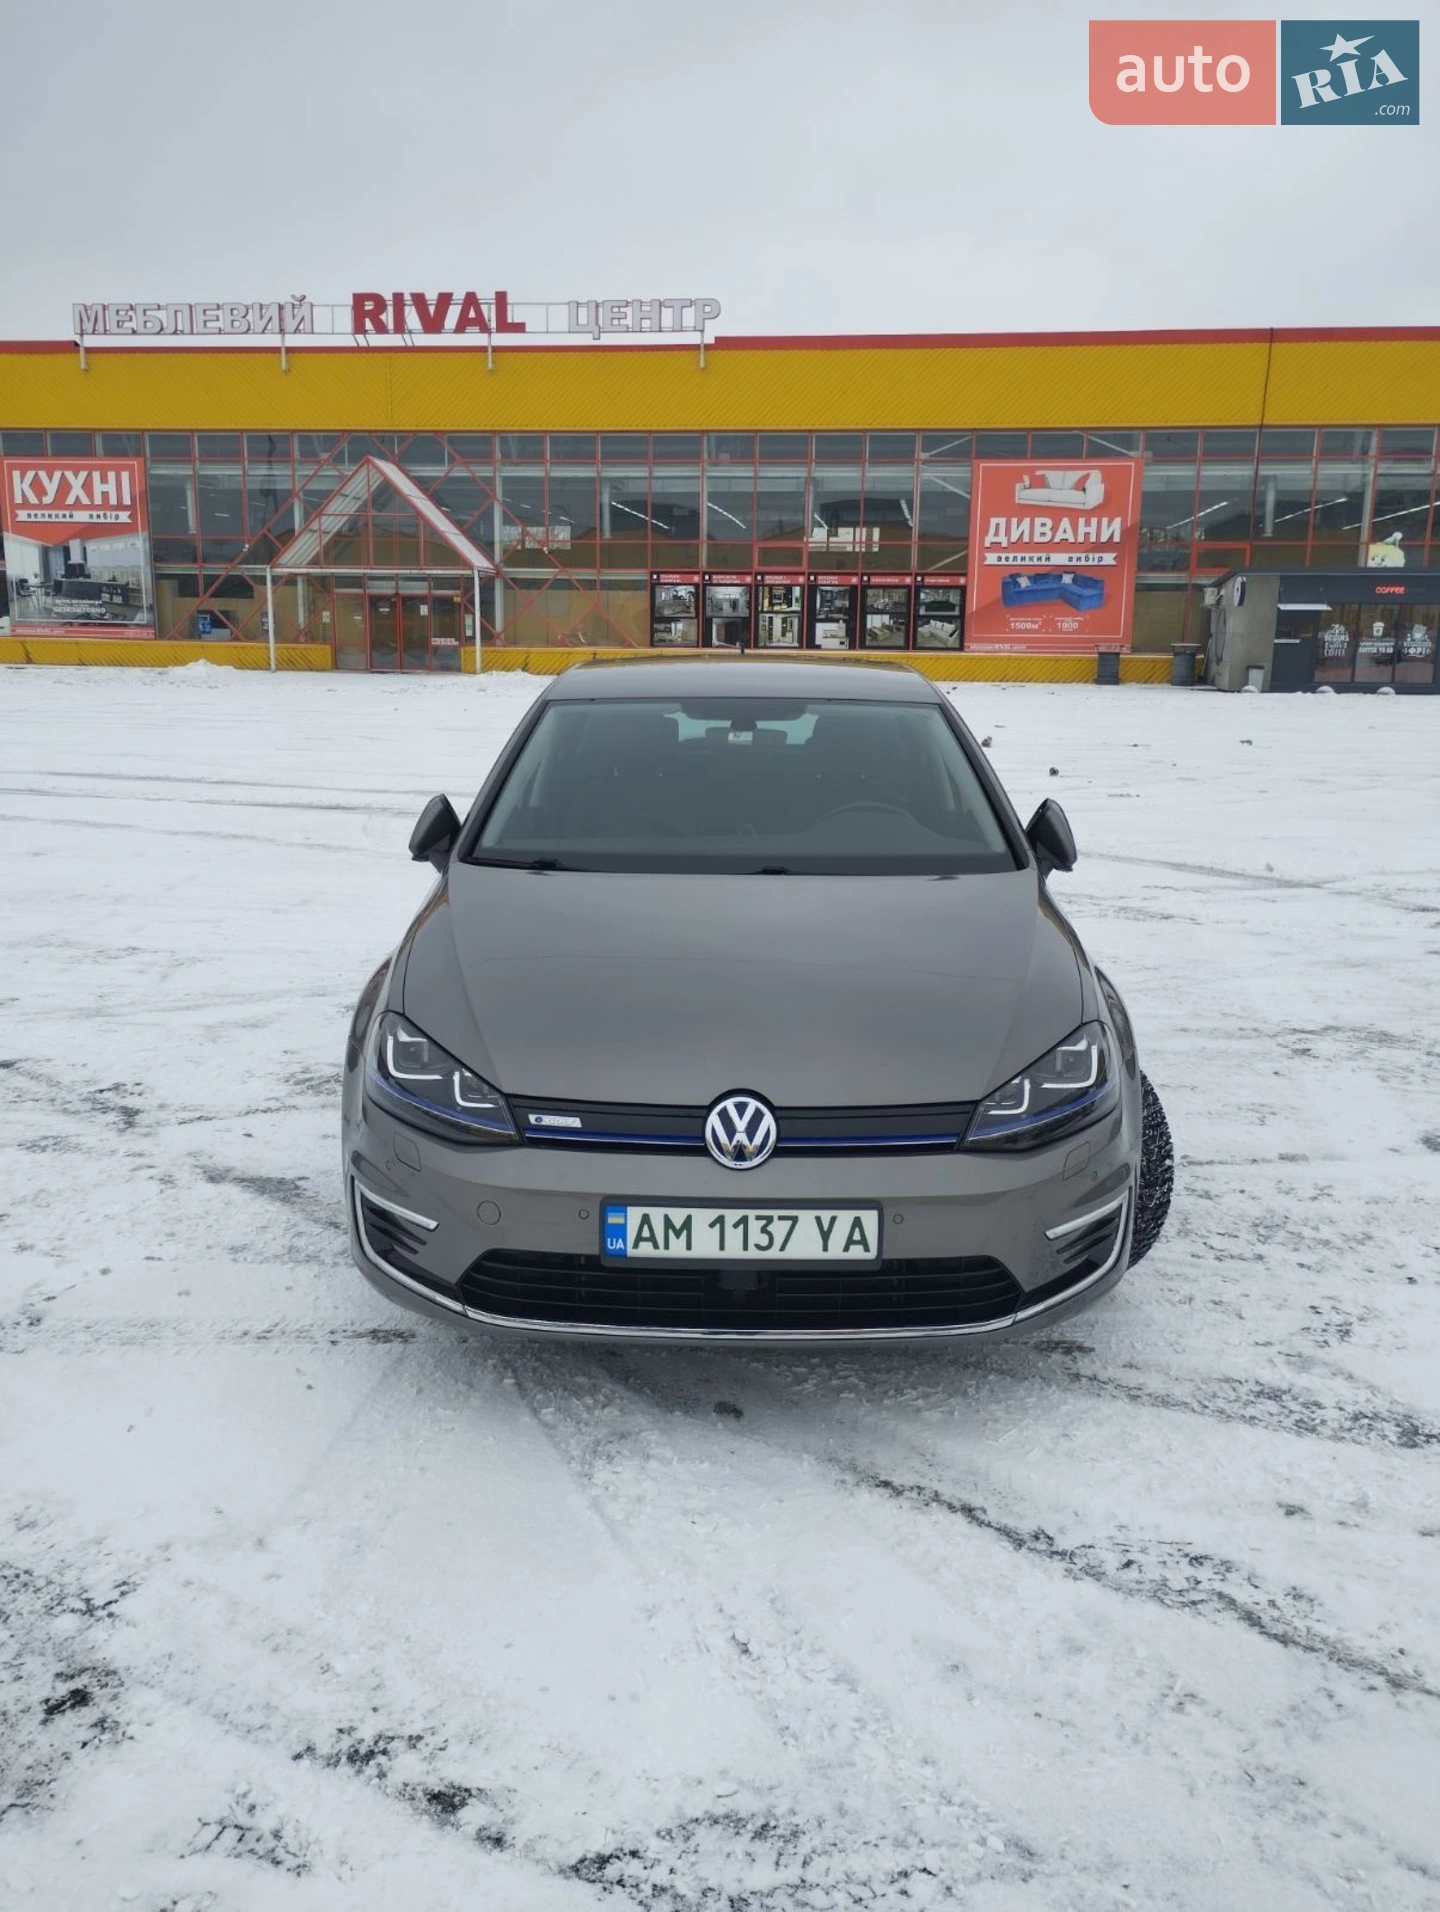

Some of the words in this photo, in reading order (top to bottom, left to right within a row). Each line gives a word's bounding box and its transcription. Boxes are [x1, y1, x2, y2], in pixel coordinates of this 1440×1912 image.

[73, 295, 314, 335] МЕБЛЕВИЙ
[352, 291, 526, 334] RIVAL
[568, 298, 721, 340] ЦЕНТР
[12, 470, 131, 505] КУХНІ
[27, 510, 75, 519] великий
[88, 511, 120, 521] вибір
[984, 517, 1122, 548] ДИВАНИ
[996, 554, 1050, 563] великий
[1067, 554, 1103, 564] вибір
[1375, 586, 1405, 594] COFFEE
[607, 1237, 625, 1250] UA
[632, 1213, 692, 1251] AM
[708, 1214, 799, 1252] 1137
[814, 1215, 871, 1253] YA
